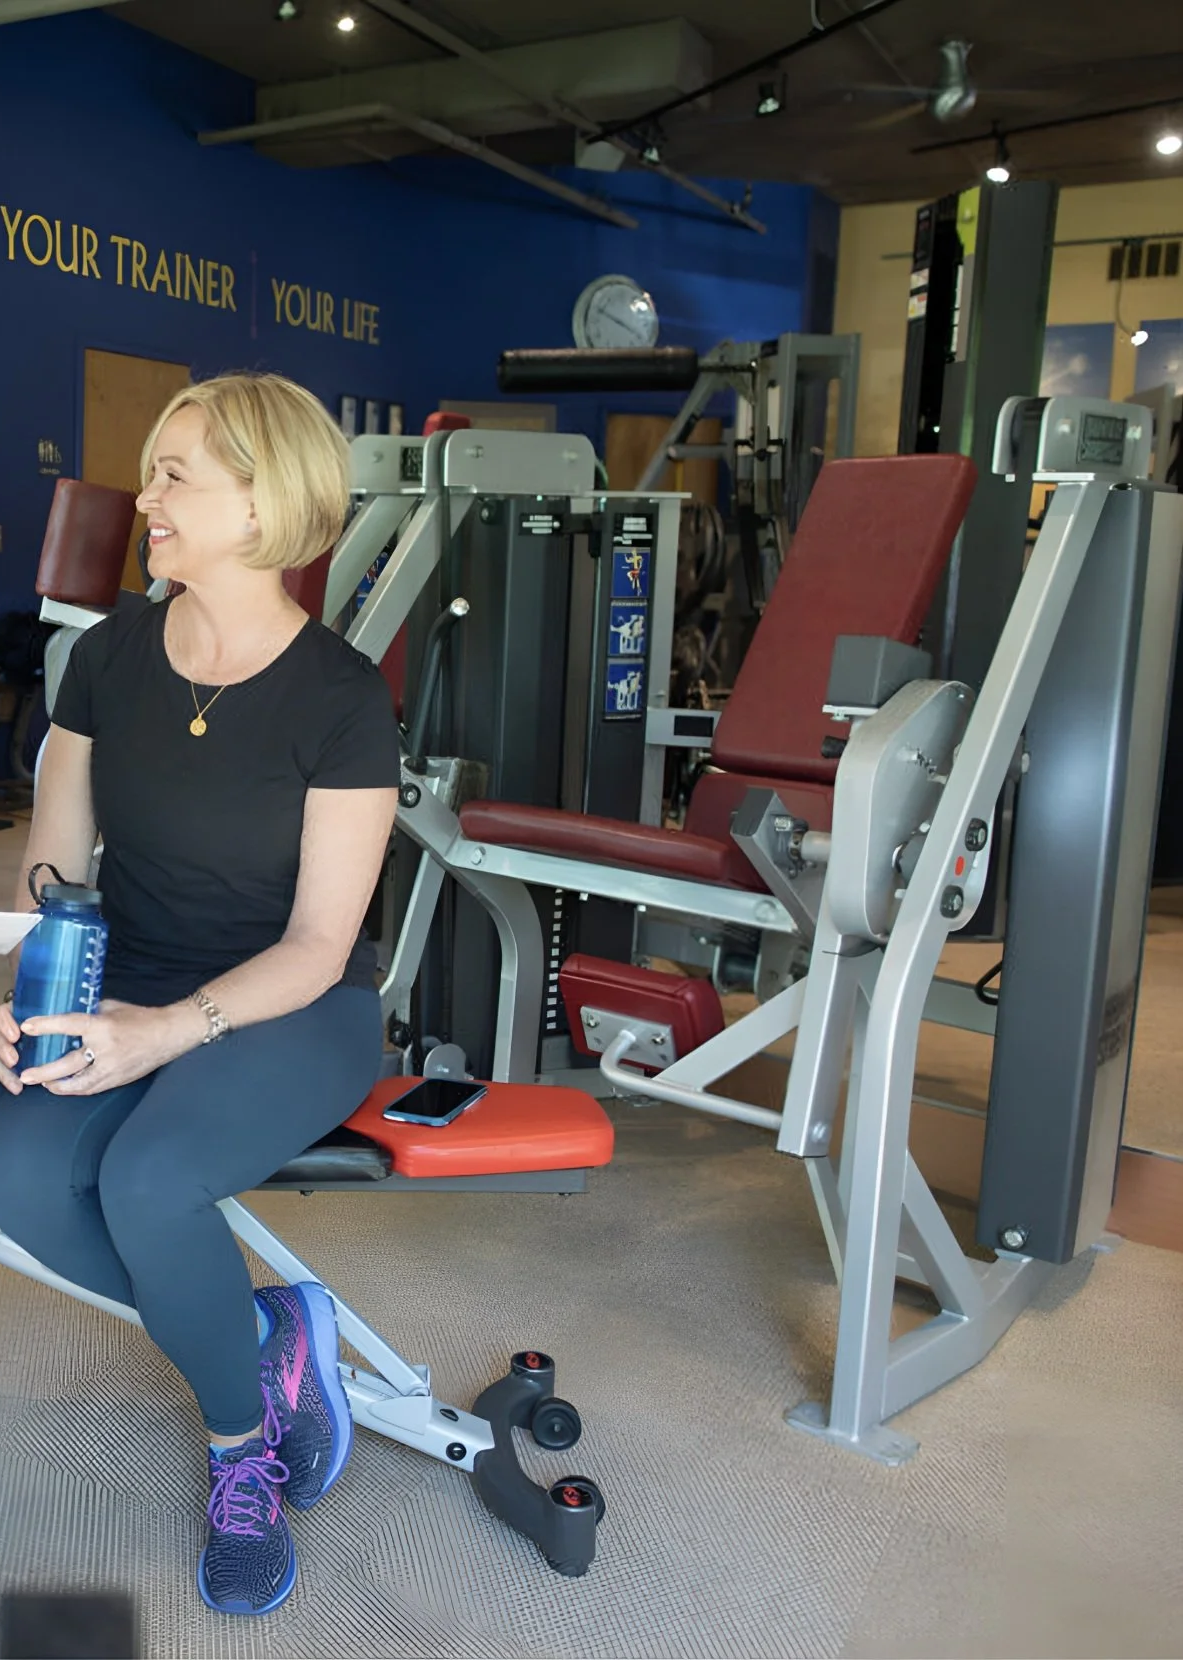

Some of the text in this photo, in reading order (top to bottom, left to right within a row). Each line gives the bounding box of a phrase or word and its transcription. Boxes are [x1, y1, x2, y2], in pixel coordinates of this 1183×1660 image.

[0, 204, 238, 313] YOUR TRAINER
[271, 277, 381, 345] YOUR LIFE
